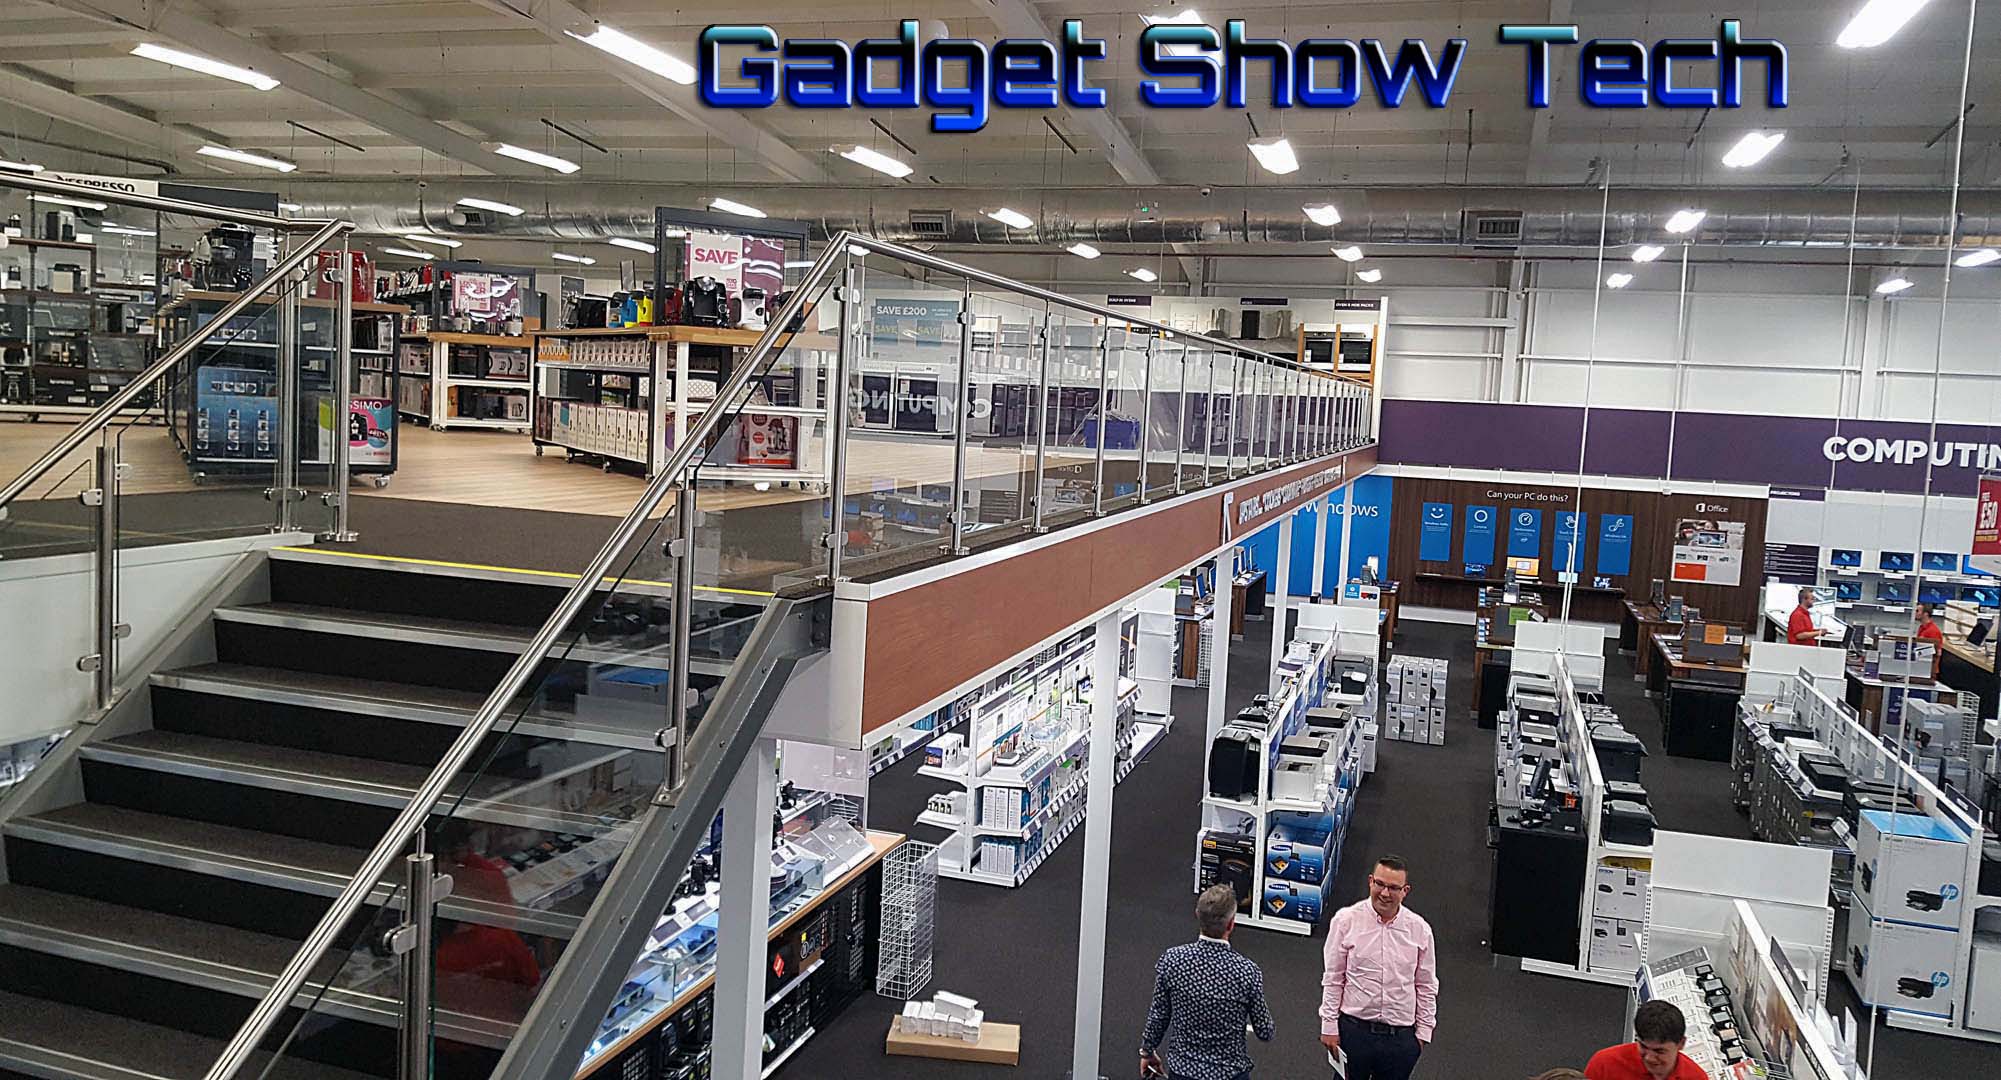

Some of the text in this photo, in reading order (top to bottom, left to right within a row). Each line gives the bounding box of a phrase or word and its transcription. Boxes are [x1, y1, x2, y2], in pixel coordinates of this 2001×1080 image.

[695, 248, 738, 264] SAVE
[877, 306, 901, 315] SAVE
[903, 307, 927, 316] £200
[1487, 490, 1502, 498] Can
[1524, 492, 1536, 500] PC
[1537, 493, 1548, 501] do
[1550, 494, 1569, 502] this?
[1707, 504, 1729, 513] Office
